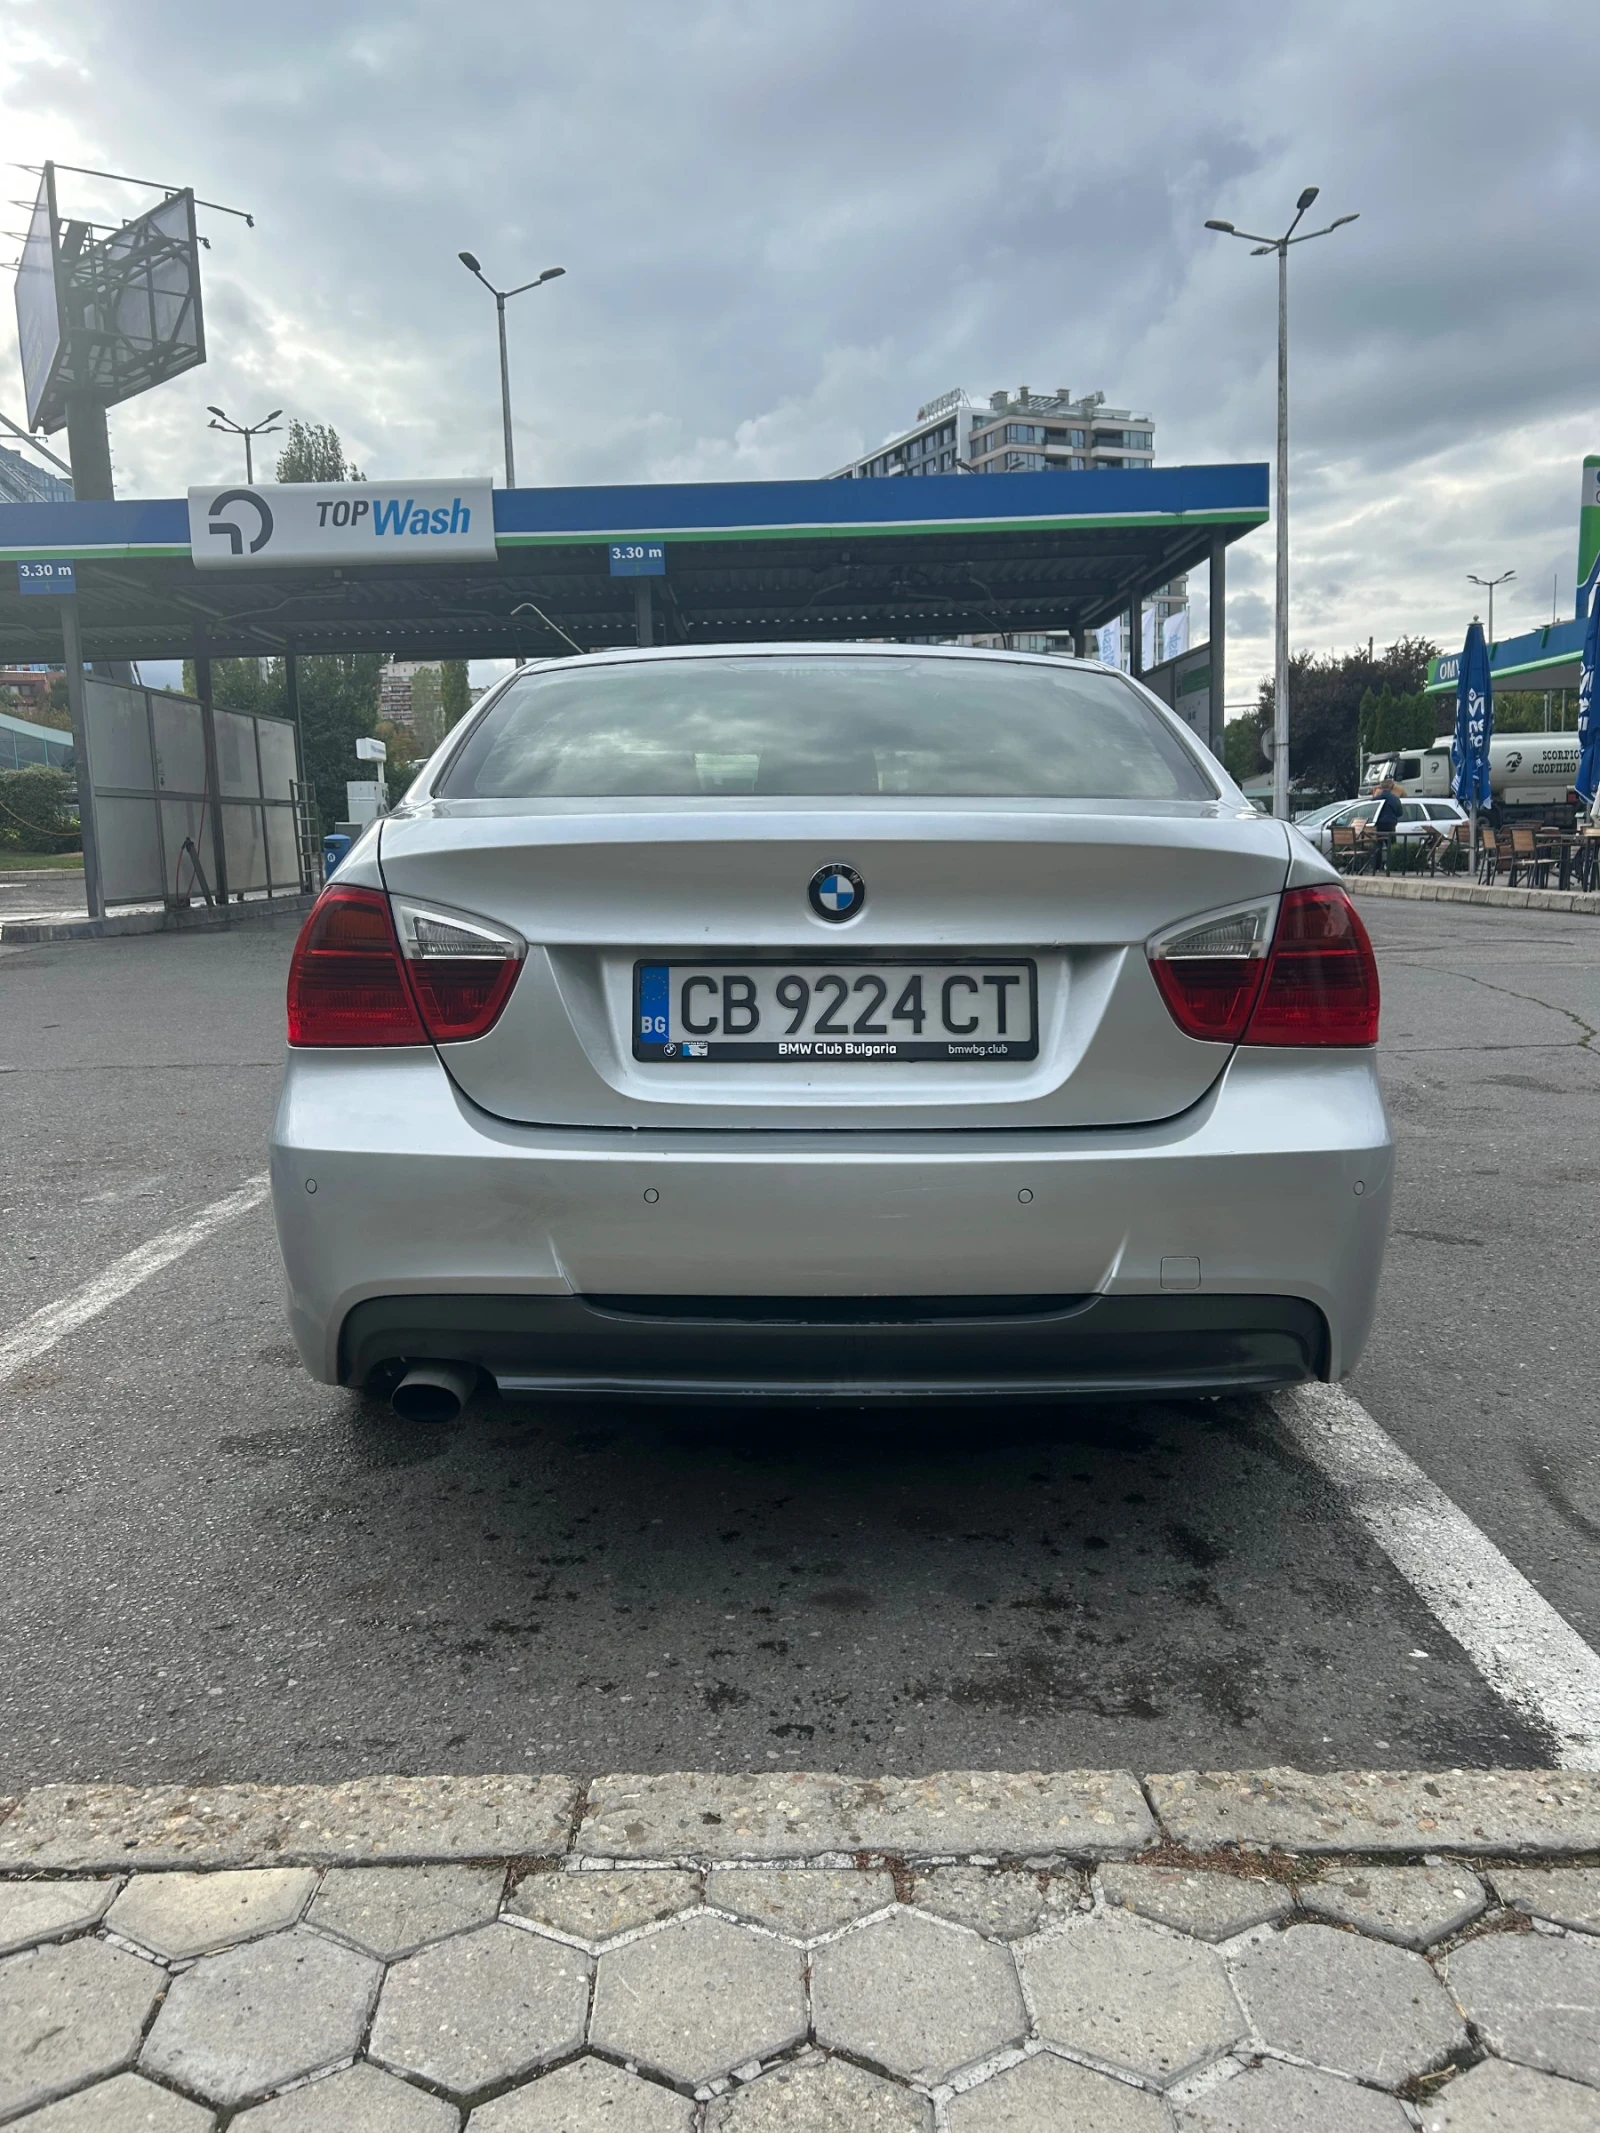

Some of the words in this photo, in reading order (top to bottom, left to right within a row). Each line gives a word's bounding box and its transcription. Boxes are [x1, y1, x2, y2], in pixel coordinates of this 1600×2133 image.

[317, 500, 369, 527] TOP
[373, 498, 471, 536] Wash
[612, 547, 644, 559] 3.30
[648, 548, 662, 558] m
[20, 564, 53, 577] 3.30
[58, 566, 72, 576] m
[814, 865, 861, 885] BMW
[681, 975, 760, 1035] CB
[775, 974, 926, 1035] 9224
[942, 974, 1020, 1034] CT
[641, 1015, 667, 1034] BG
[778, 1043, 812, 1055] BMW
[814, 1043, 842, 1055] Club
[845, 1043, 897, 1057] Bulgaria
[948, 1044, 1008, 1056] bmwbg.club
